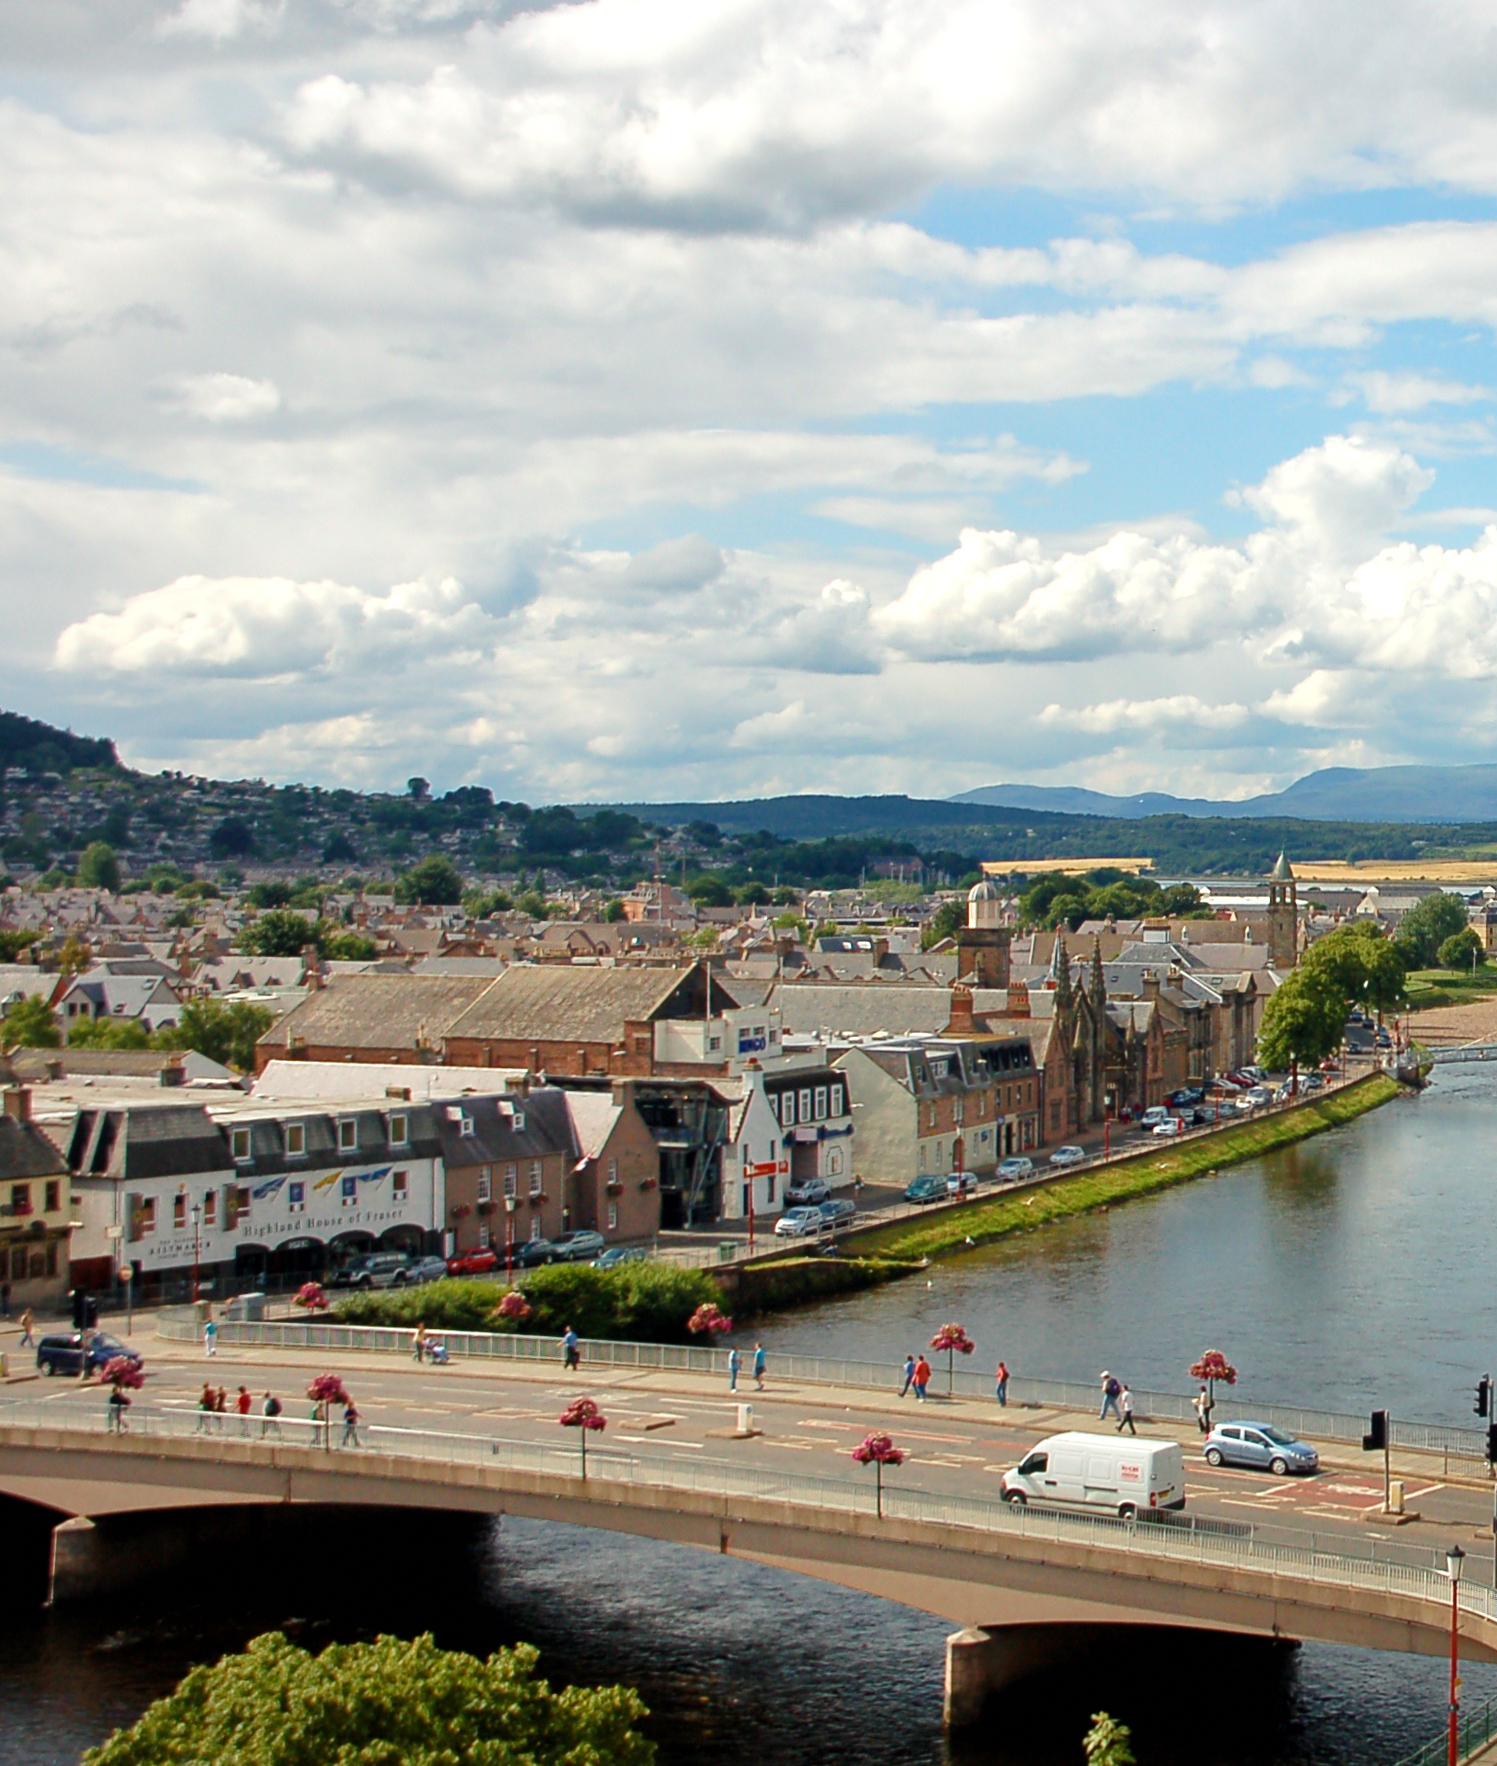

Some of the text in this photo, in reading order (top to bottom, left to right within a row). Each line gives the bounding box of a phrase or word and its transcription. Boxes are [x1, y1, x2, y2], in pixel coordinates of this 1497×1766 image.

[244, 1208, 403, 1237] Highland House of Fraser
